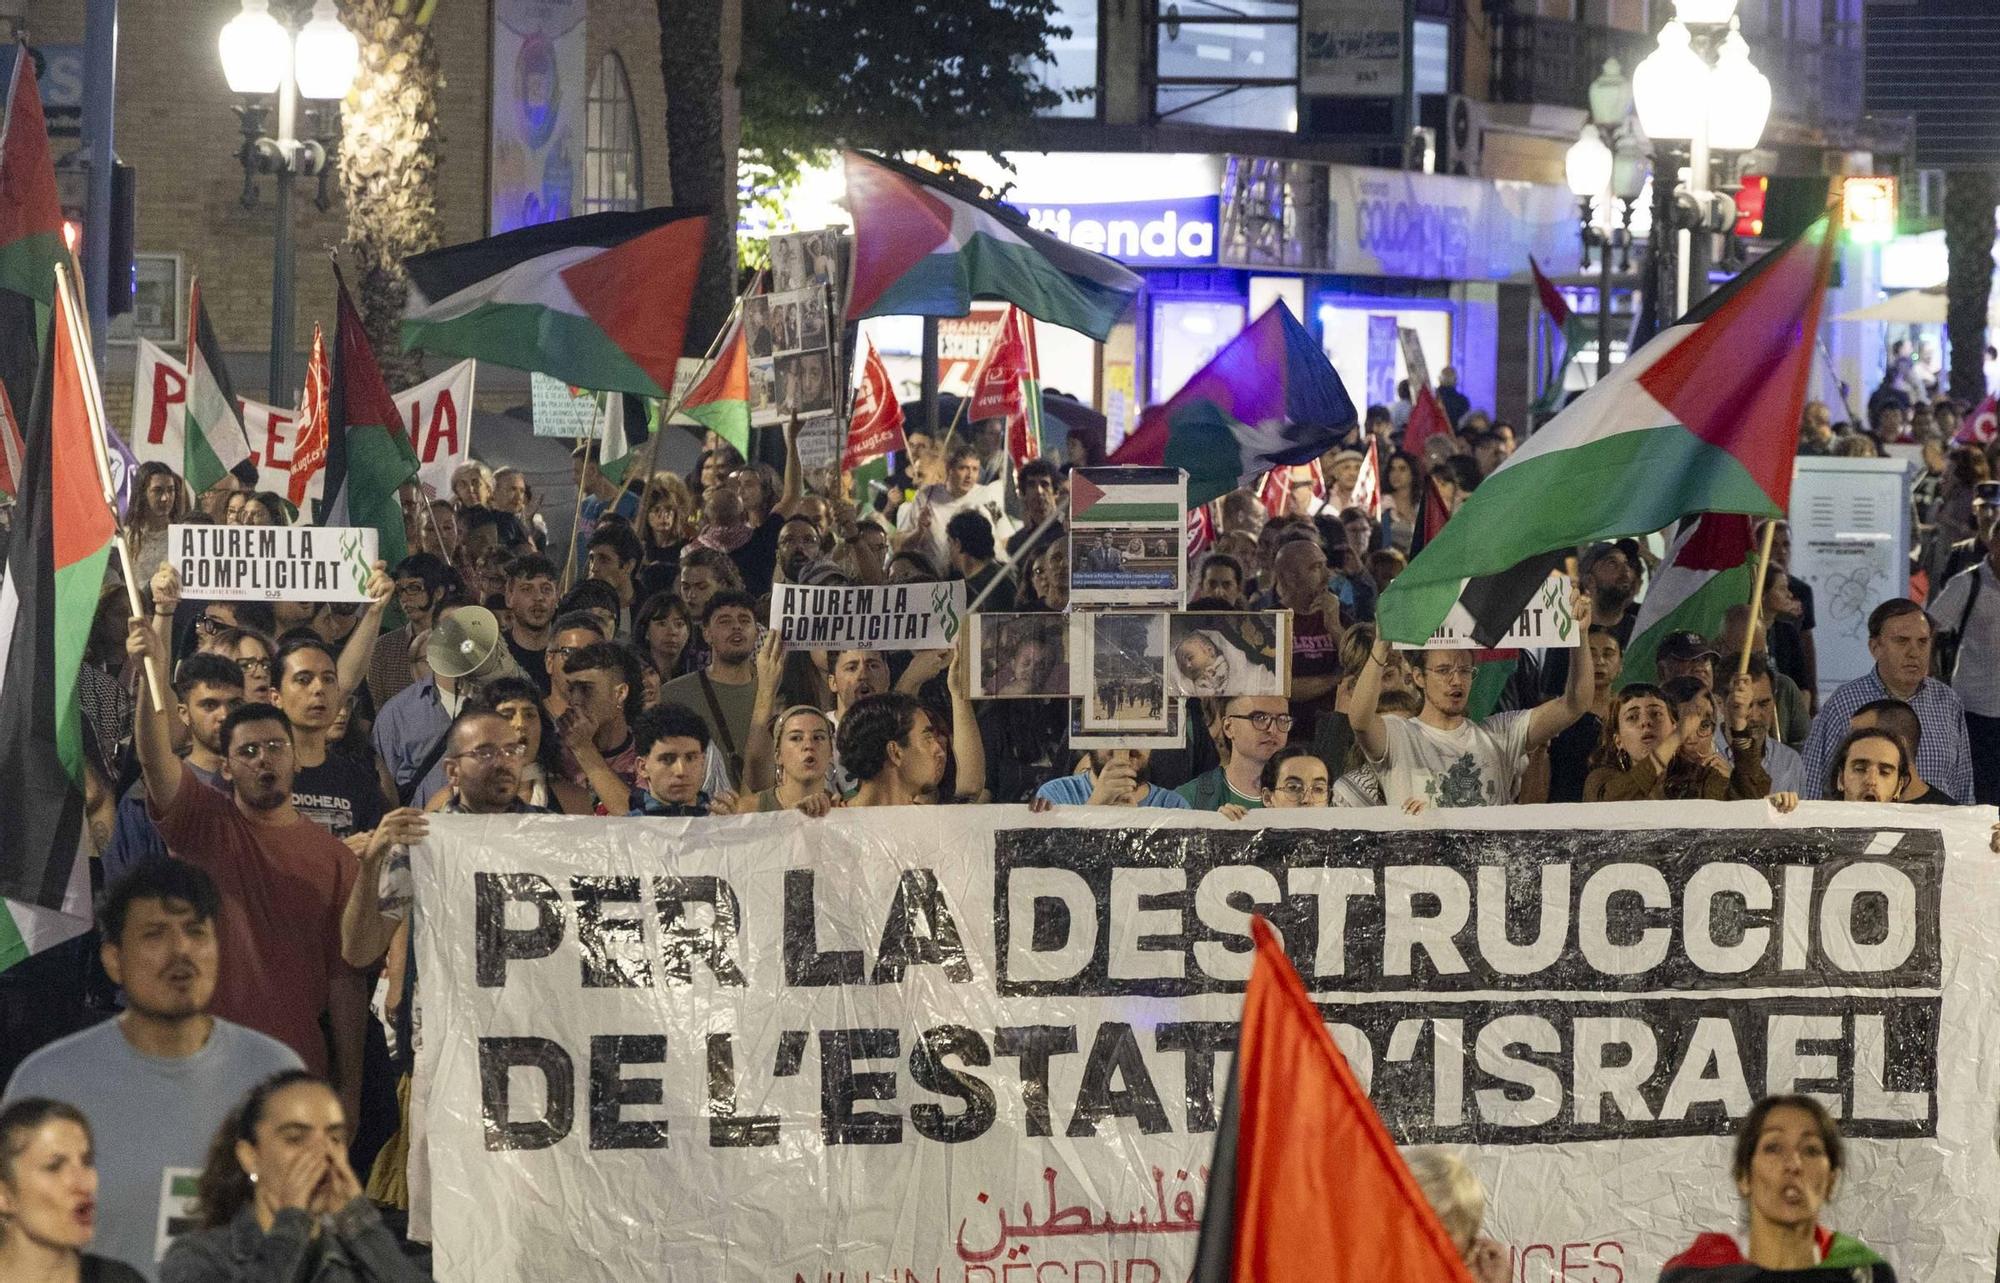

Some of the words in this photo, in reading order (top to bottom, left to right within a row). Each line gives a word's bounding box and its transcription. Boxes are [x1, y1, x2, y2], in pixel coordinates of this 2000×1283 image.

[181, 528, 277, 558] ATUREM
[287, 530, 313, 559] LA
[181, 558, 341, 590] COMPLICITAT
[782, 587, 875, 616] ATUREM
[882, 587, 908, 614] LA
[781, 612, 931, 642] COMPLICITAT
[474, 870, 748, 988] PER
[783, 868, 974, 986] LA
[1006, 832, 1917, 984] DESTRUCCIÓ
[478, 1033, 669, 1152] DE
[706, 1020, 1240, 1149] L'ESTAT
[956, 1165, 1208, 1263] فلسطين
